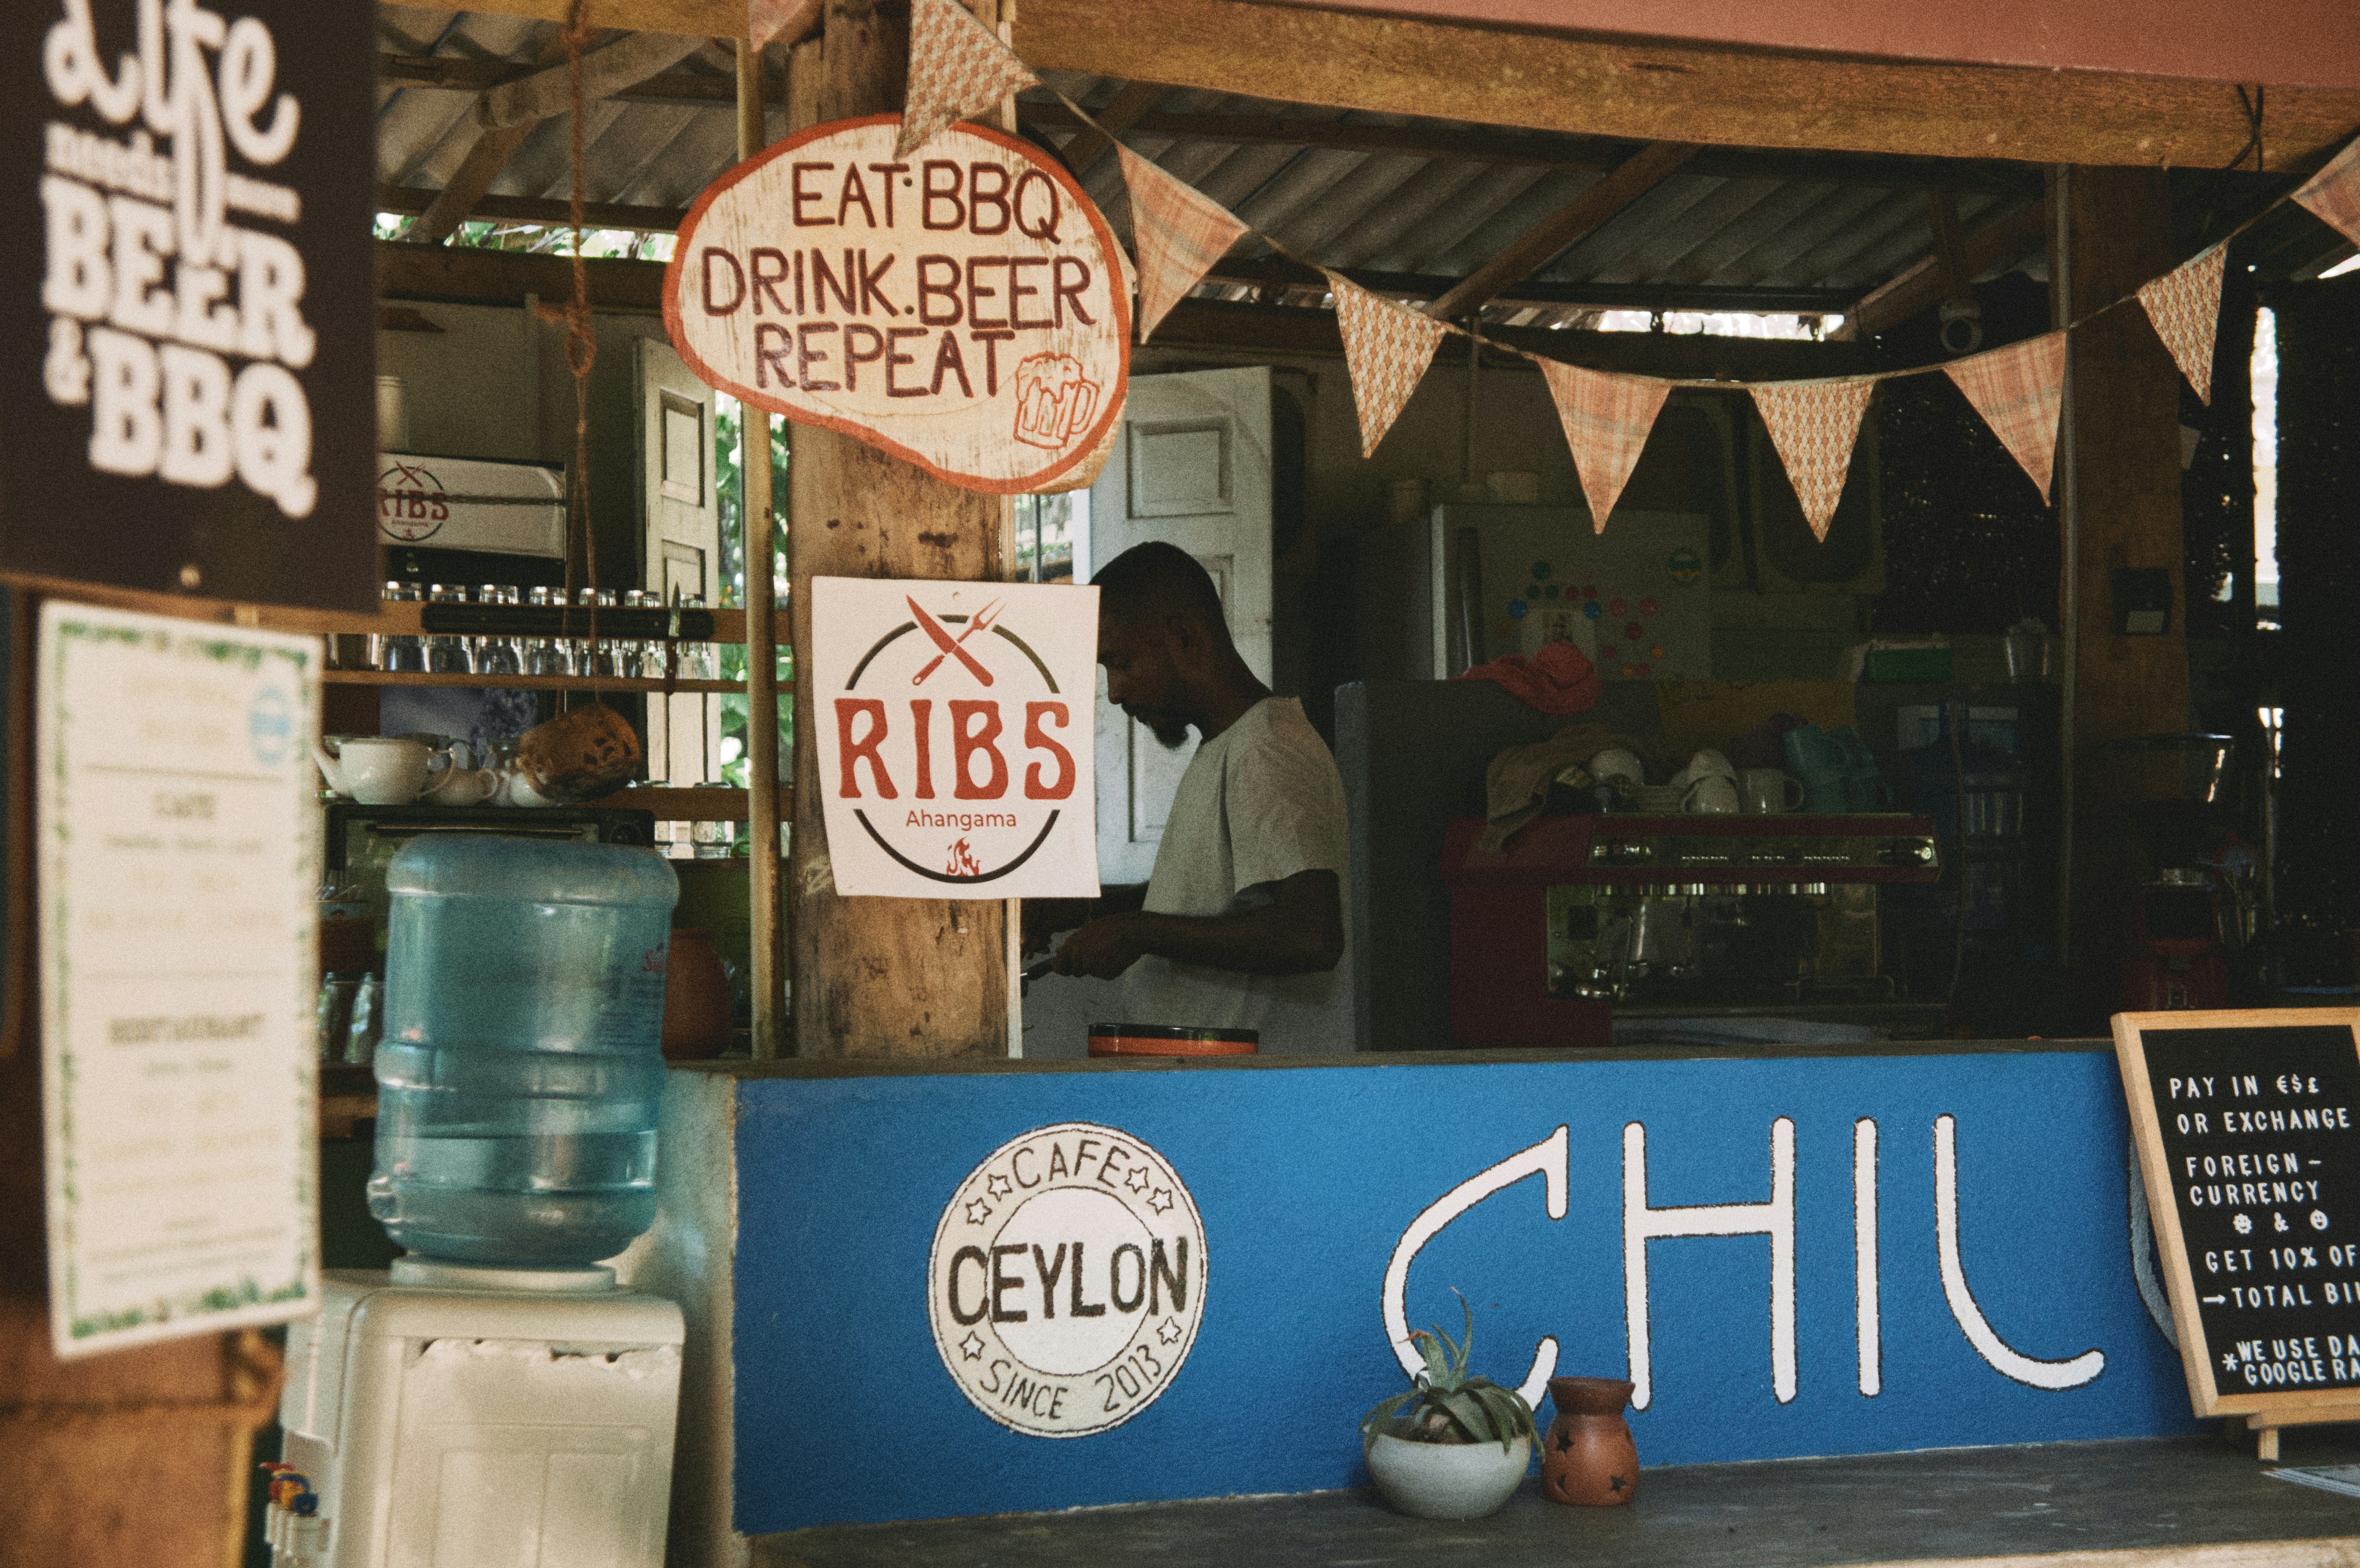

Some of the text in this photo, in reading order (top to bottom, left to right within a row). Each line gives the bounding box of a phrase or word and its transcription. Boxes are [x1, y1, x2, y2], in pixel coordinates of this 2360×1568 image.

[791, 159, 1062, 245] EAT BBQ
[41, 172, 316, 369] BEER
[917, 253, 1097, 330] BEER
[754, 321, 1015, 399] REPEAT
[89, 327, 317, 518] BBQ
[834, 698, 1076, 800] RIBS
[906, 809, 1017, 832] Ahangama
[2169, 1077, 2214, 1099] PAY
[2232, 1075, 2259, 1097] IN
[2177, 1107, 2350, 1135] OR EXCHANGE
[1012, 1139, 1130, 1188] CAFE
[2189, 1180, 2318, 1206] CURRENCY
[948, 1236, 1188, 1326] CEYLON
[2205, 1249, 2251, 1273] GET
[2270, 1247, 2317, 1270] 10%
[2231, 1285, 2312, 1308] TOTAL
[2273, 1337, 2319, 1360] USE
[980, 1345, 1162, 1419] SINCE 2013
[2244, 1362, 2327, 1386] GOOGLE
